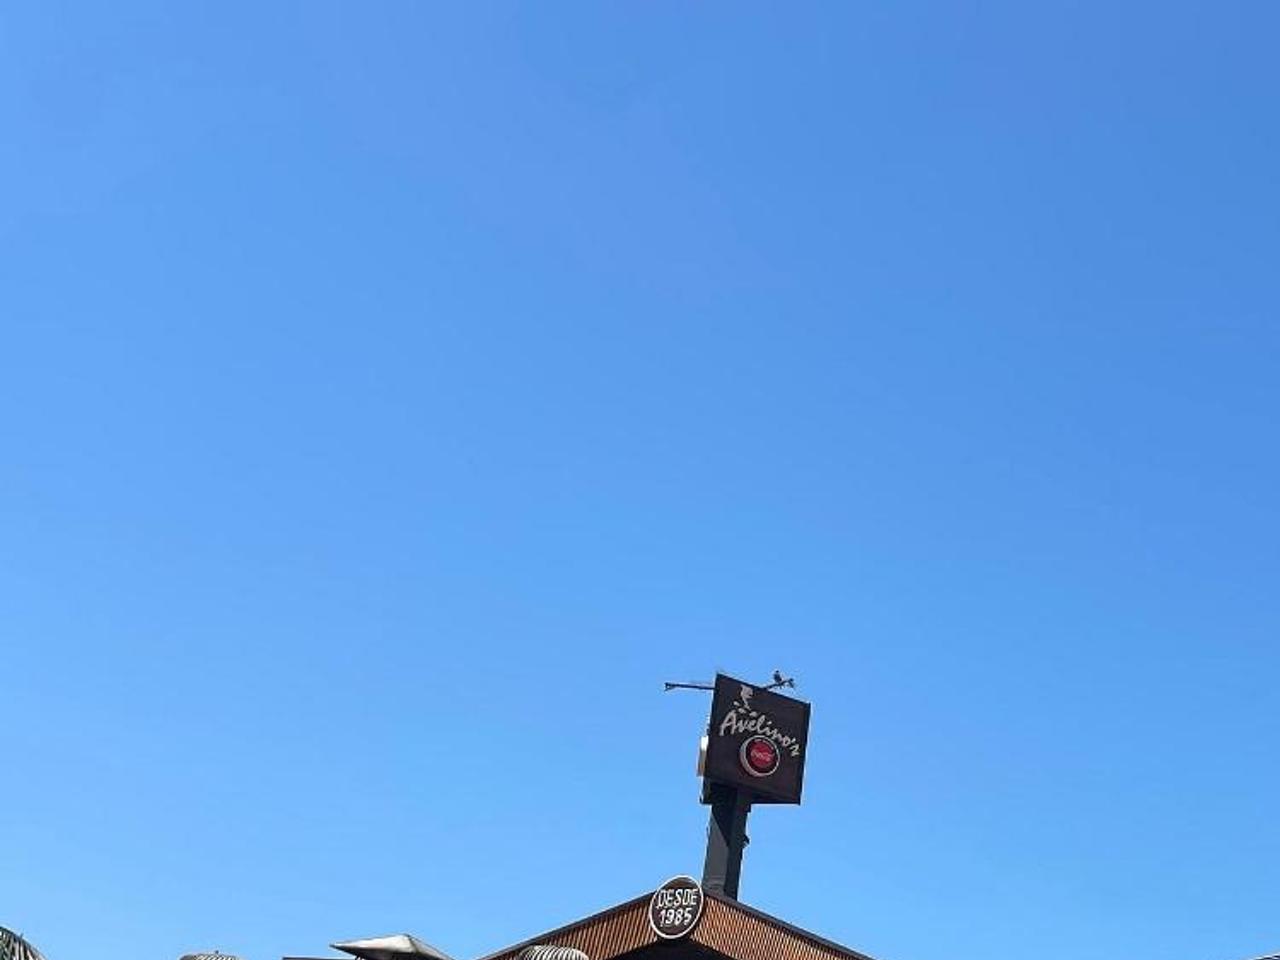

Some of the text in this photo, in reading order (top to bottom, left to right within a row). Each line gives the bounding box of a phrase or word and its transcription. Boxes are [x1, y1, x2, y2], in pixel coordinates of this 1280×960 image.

[719, 710, 800, 757] Avelino's
[658, 888, 698, 909] DESDE
[659, 908, 692, 928] 1985
